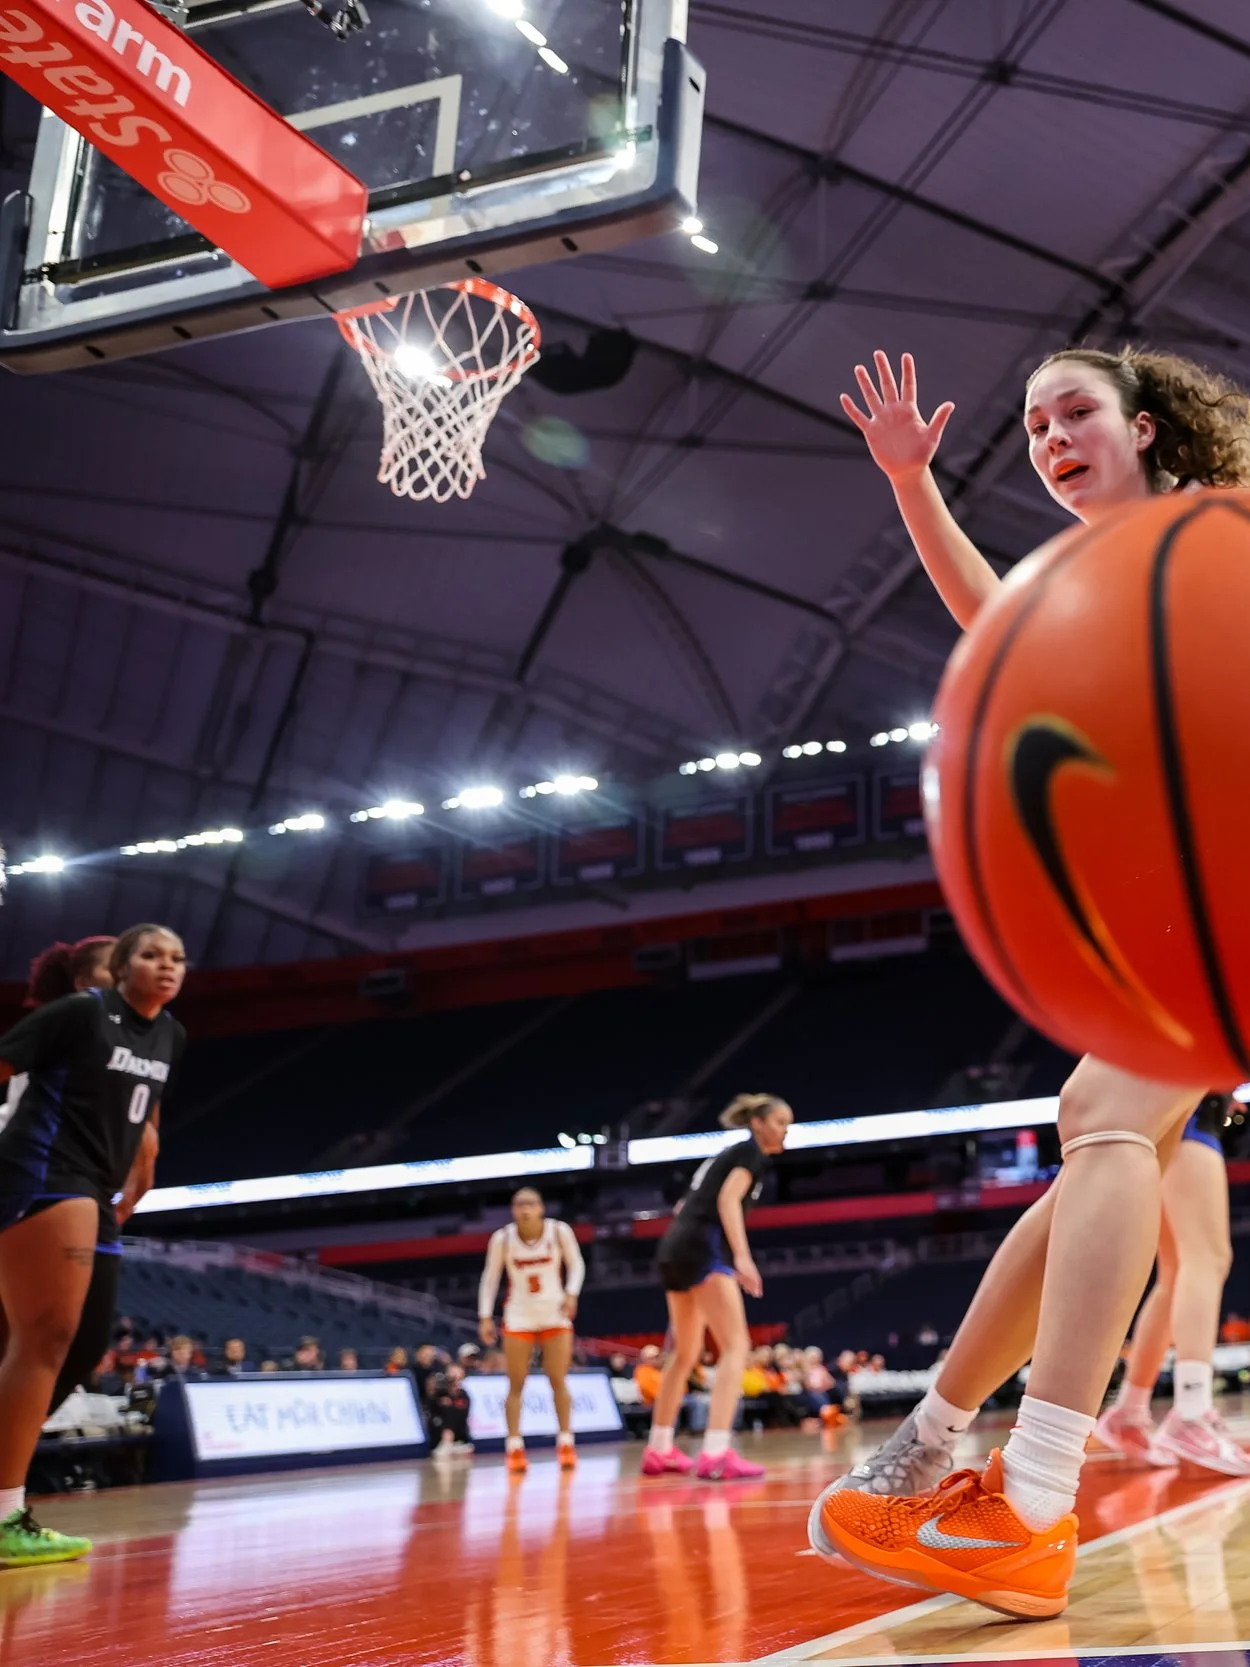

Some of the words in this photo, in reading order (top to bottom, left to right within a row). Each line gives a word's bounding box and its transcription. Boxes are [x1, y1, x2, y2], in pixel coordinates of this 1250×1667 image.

[0, 9, 173, 147] State
[54, 0, 192, 107] arm
[128, 1083, 151, 1124] 0
